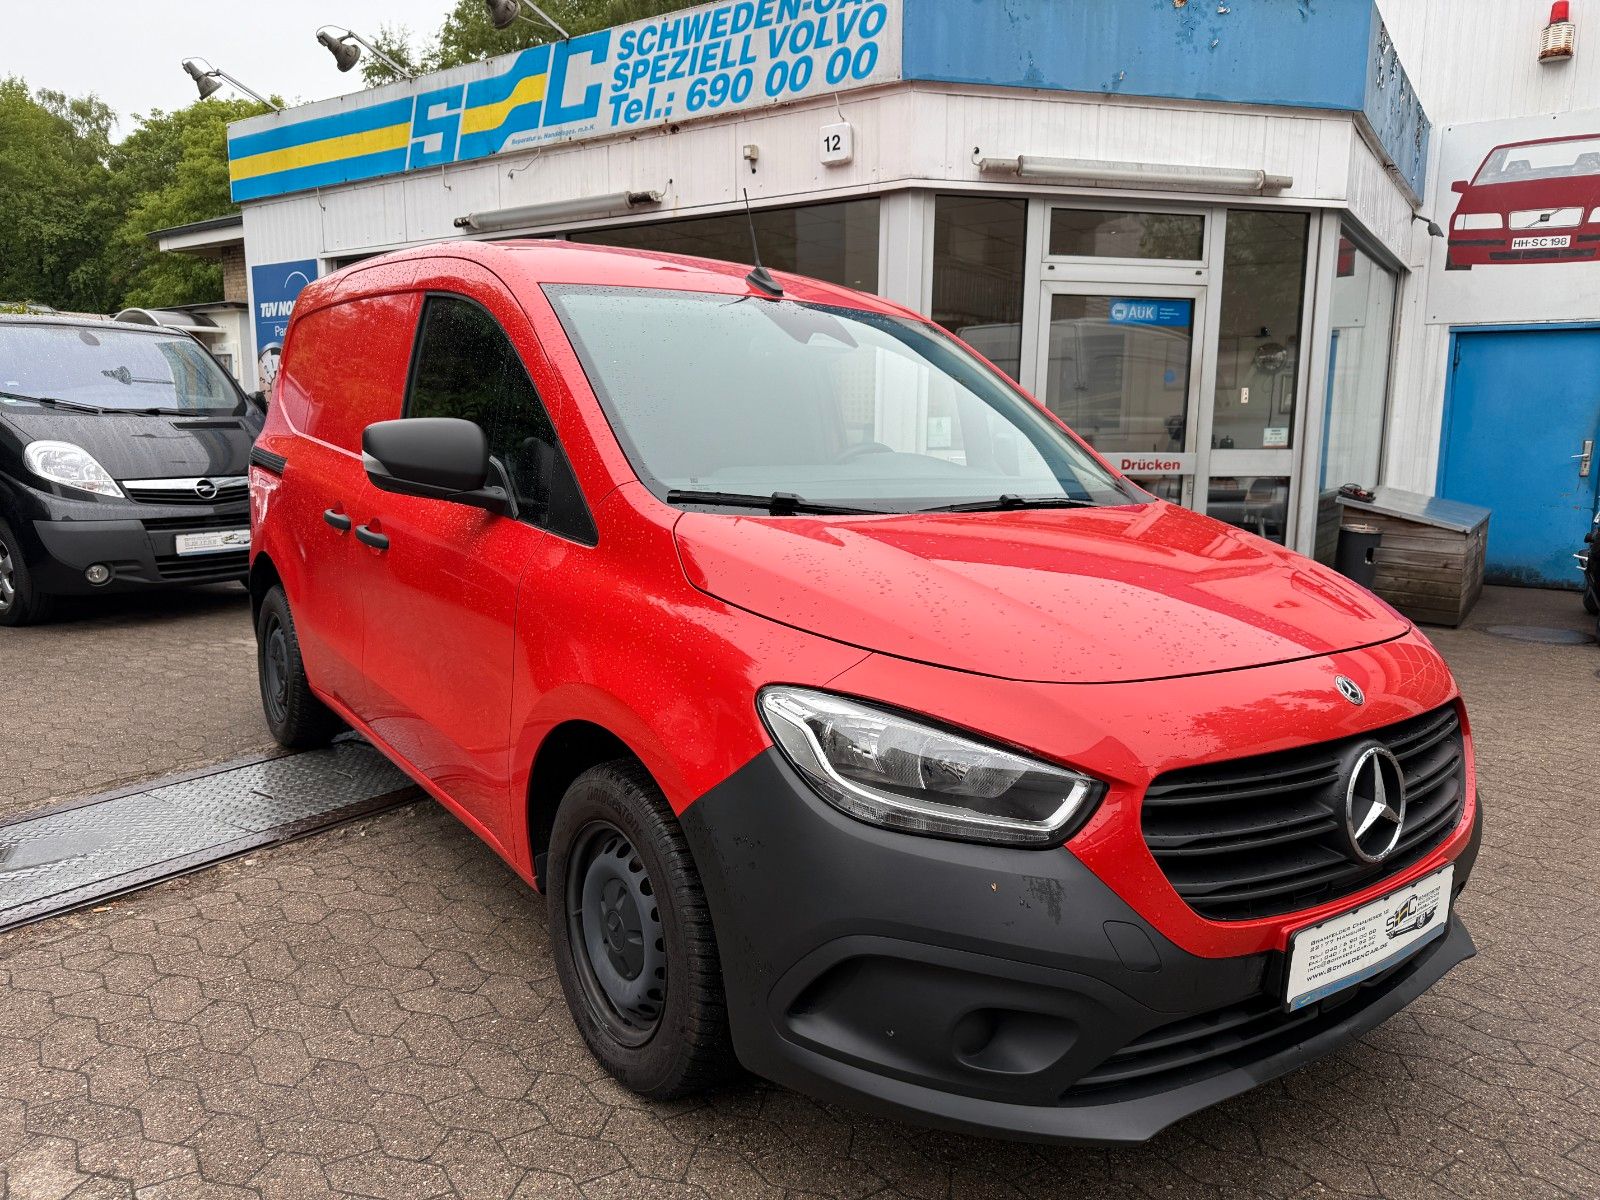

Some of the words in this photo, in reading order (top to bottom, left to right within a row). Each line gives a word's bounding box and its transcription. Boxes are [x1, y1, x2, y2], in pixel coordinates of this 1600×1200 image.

[617, 0, 874, 60] SCHWEDEN-
[611, 34, 757, 92] SPEZIELL
[769, 3, 887, 59] VOLVO
[609, 87, 675, 126] Tel.:
[686, 68, 753, 112] 690
[765, 55, 813, 97] 00
[826, 42, 879, 85] 00
[824, 135, 841, 152] 12
[1551, 237, 1568, 246] 198
[260, 302, 278, 317] TÜV
[278, 300, 296, 316] NO
[1121, 458, 1181, 471] Drücken
